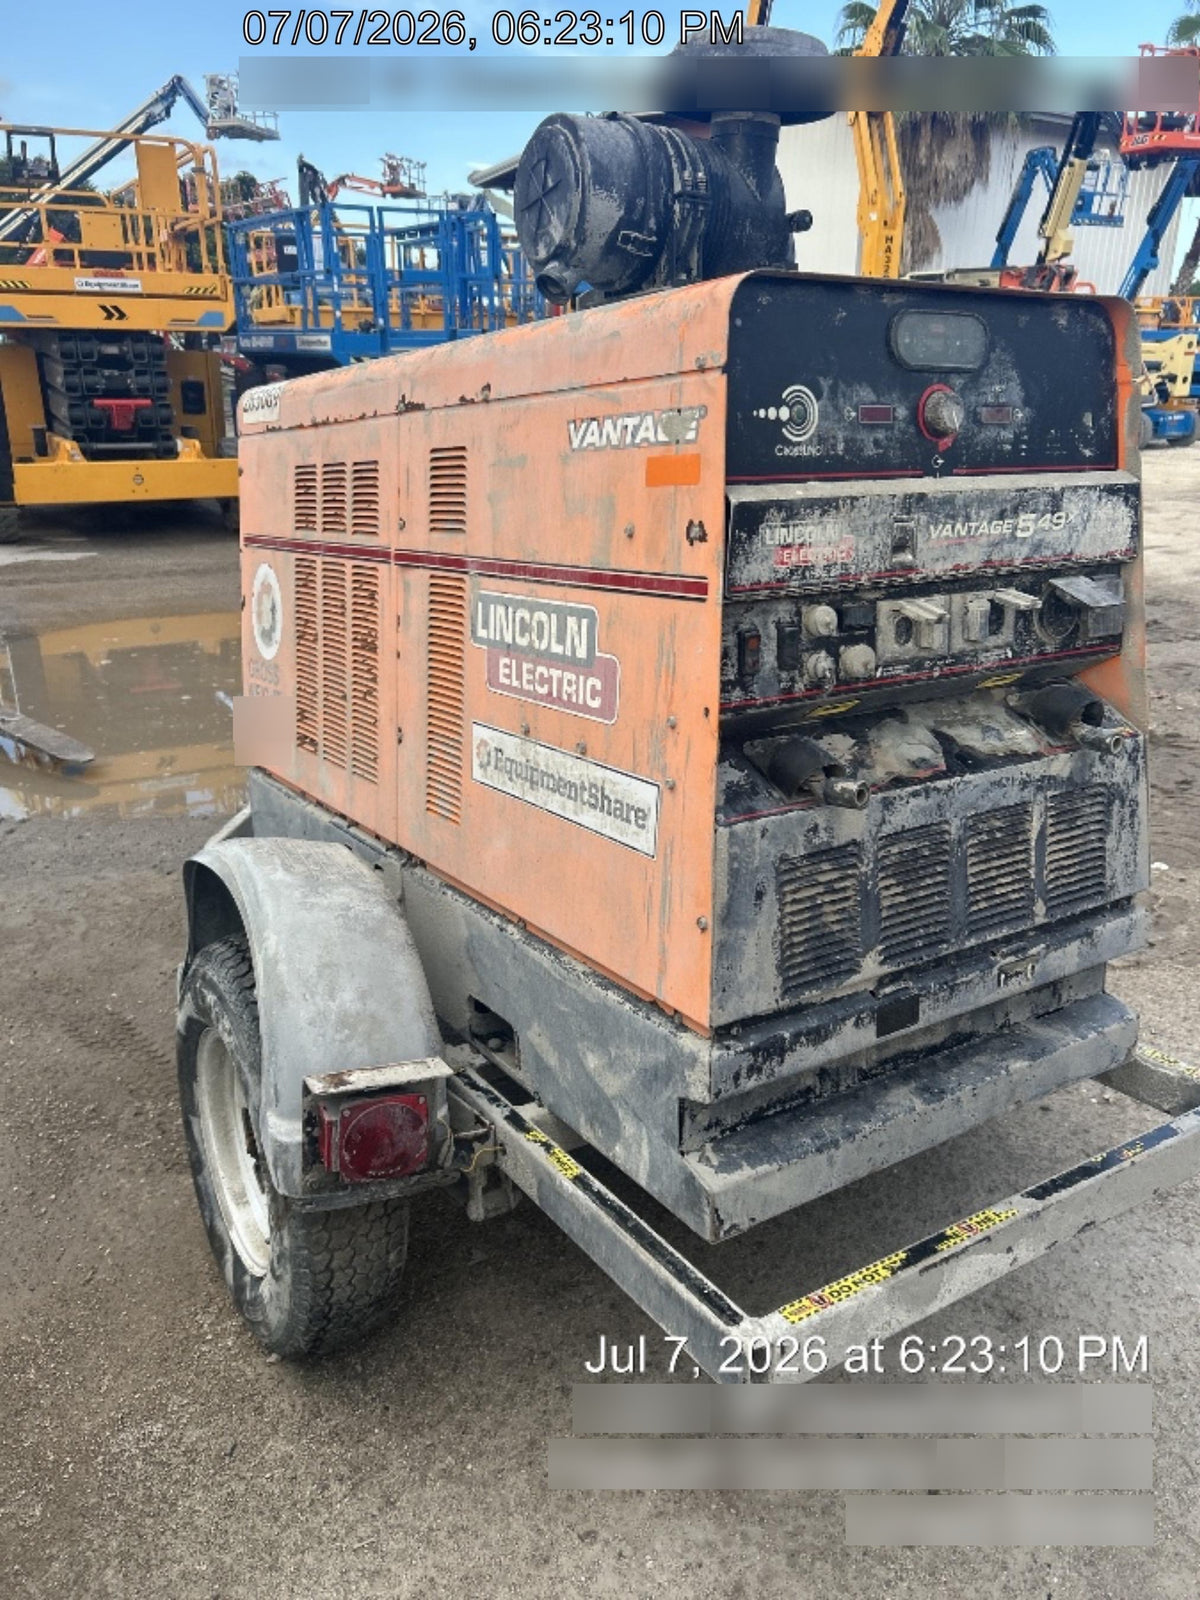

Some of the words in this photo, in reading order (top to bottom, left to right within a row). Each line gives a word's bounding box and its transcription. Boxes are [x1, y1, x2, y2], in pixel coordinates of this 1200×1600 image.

[929, 519, 1013, 539] VANTAGE
[476, 601, 588, 660] LINCOLN
[498, 656, 602, 709] ELECTRIC
[493, 745, 648, 830] EquipmentShare
[828, 1284, 852, 1299] DO
